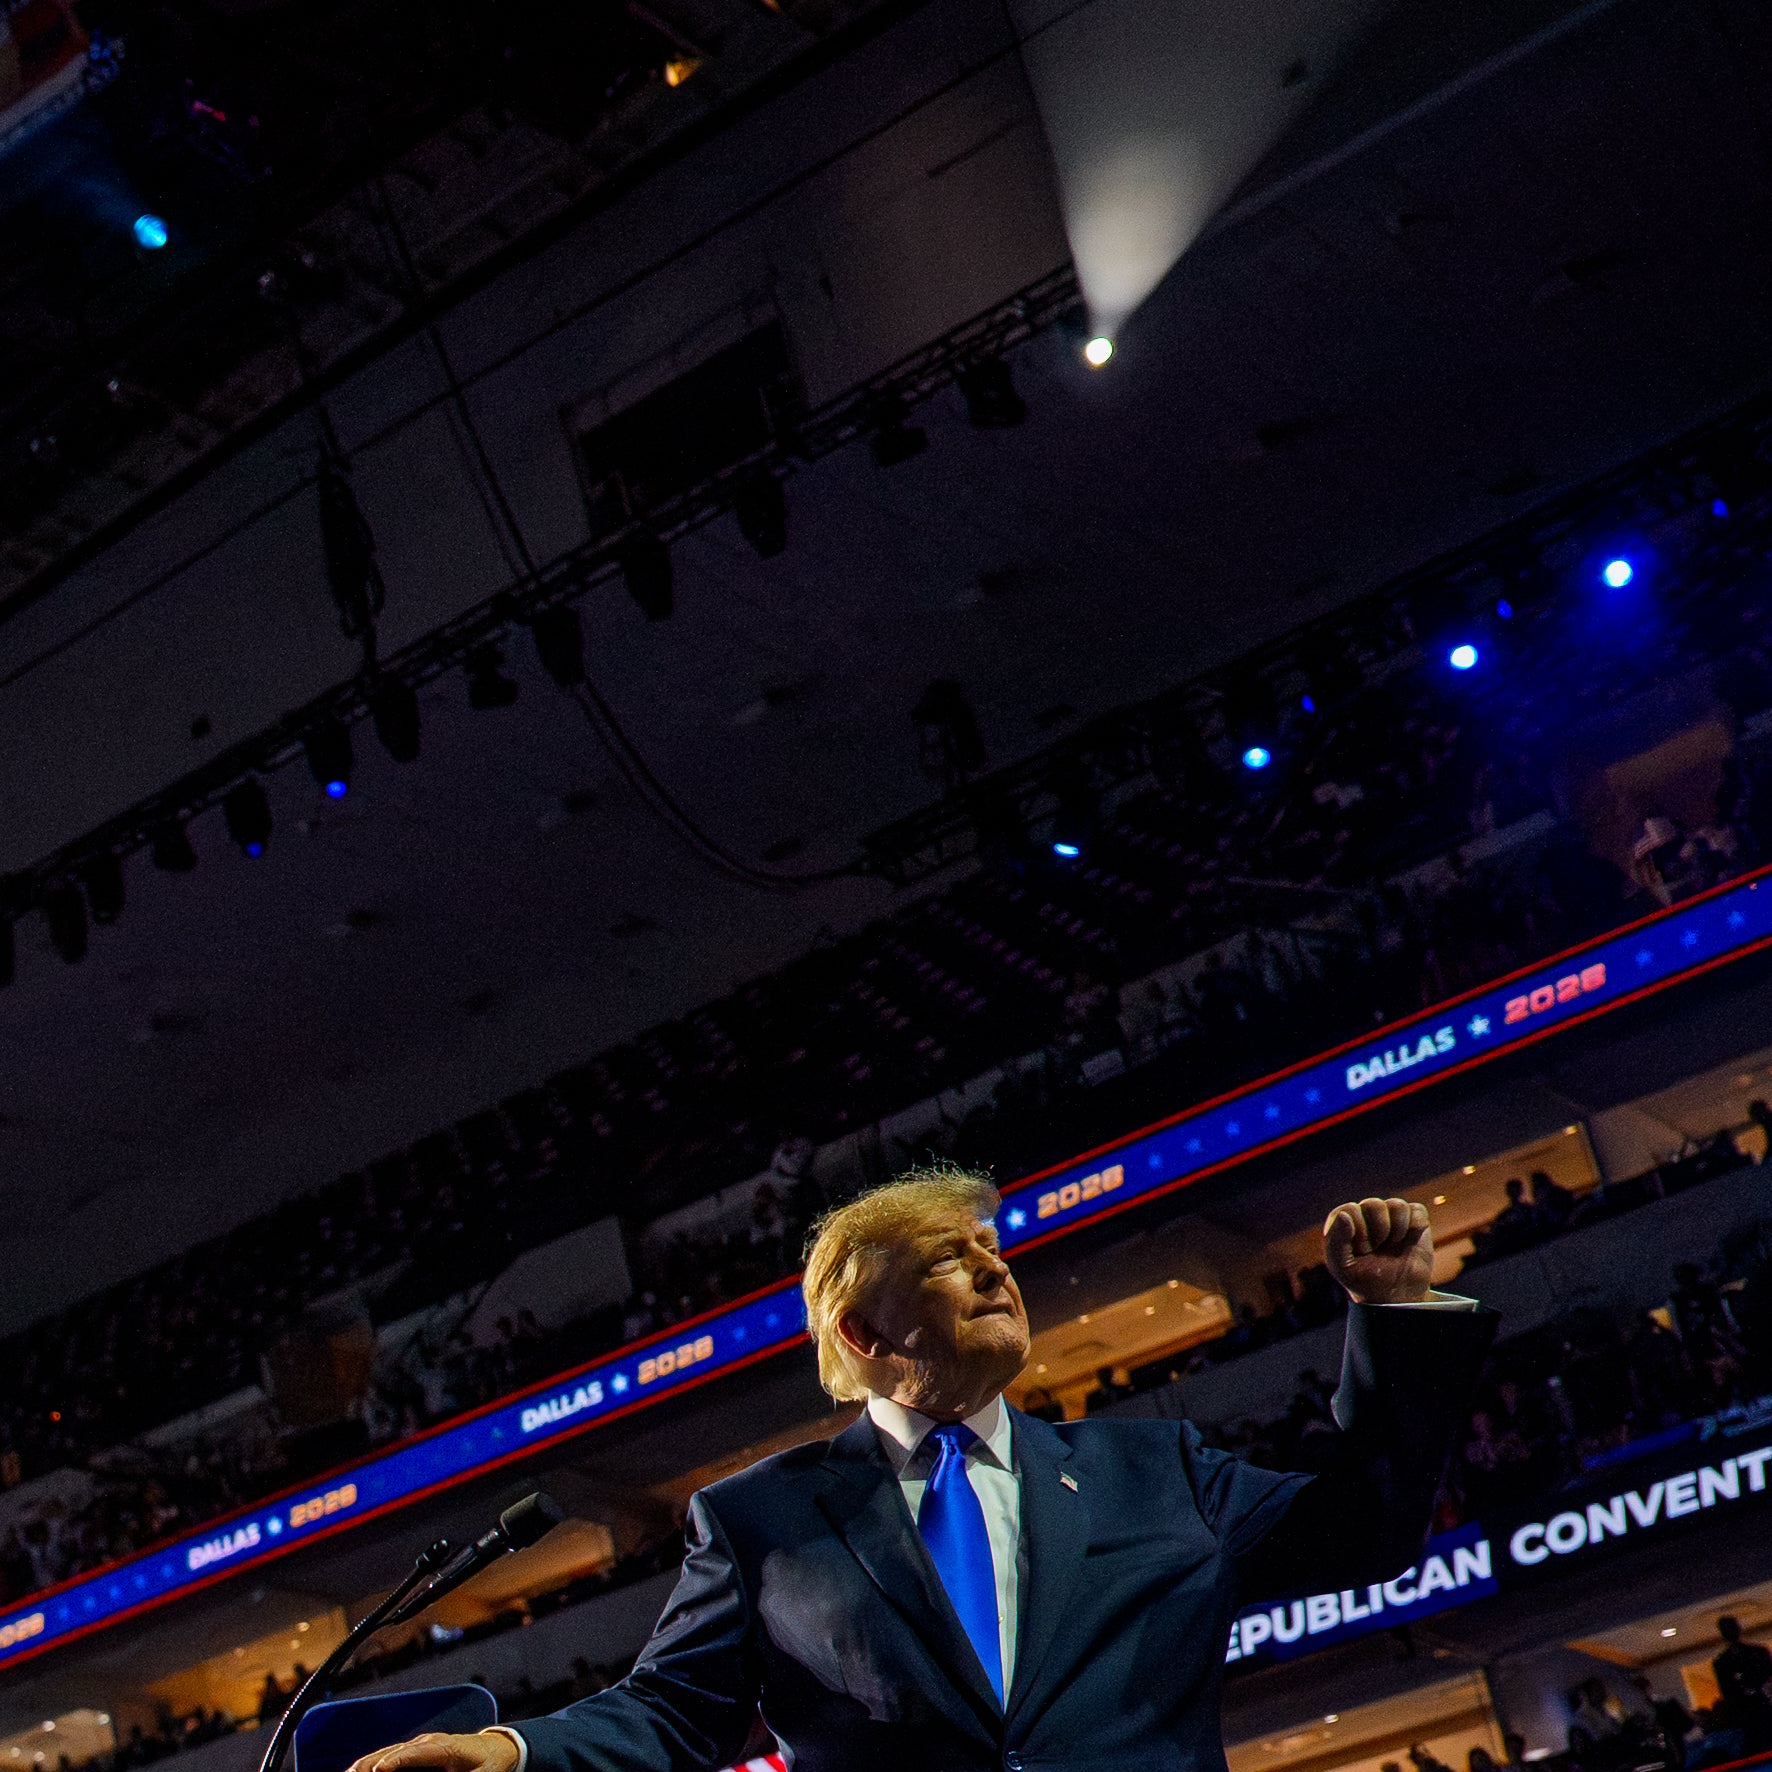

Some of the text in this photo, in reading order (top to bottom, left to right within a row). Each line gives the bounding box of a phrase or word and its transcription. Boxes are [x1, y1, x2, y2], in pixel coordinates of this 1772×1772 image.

[1347, 1028, 1454, 1089] DALLAS
[522, 1382, 602, 1431] DALLAS
[189, 1524, 260, 1569] DALLAS
